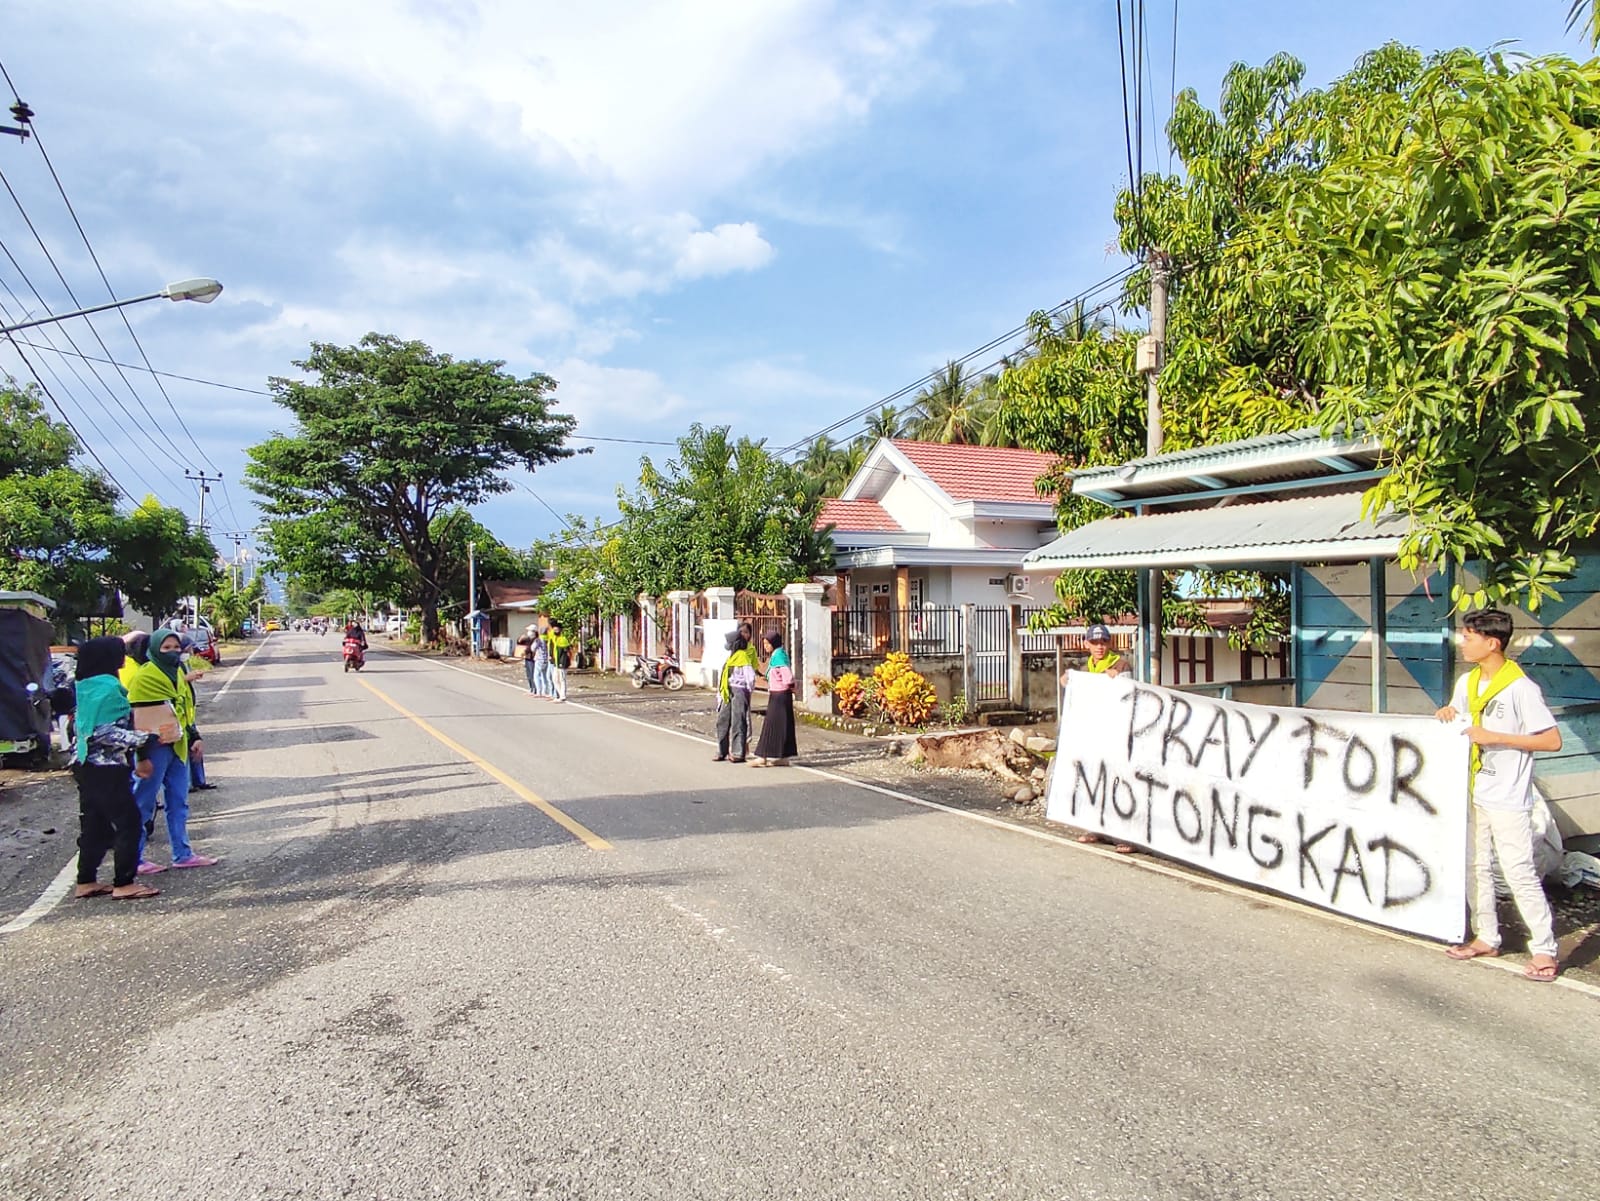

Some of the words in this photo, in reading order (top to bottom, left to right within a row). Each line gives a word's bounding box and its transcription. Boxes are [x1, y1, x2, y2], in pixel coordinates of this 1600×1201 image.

[1122, 687, 1279, 780] PRAY
[1292, 716, 1438, 816] FOR
[1071, 760, 1432, 908] MOTONGKAD
